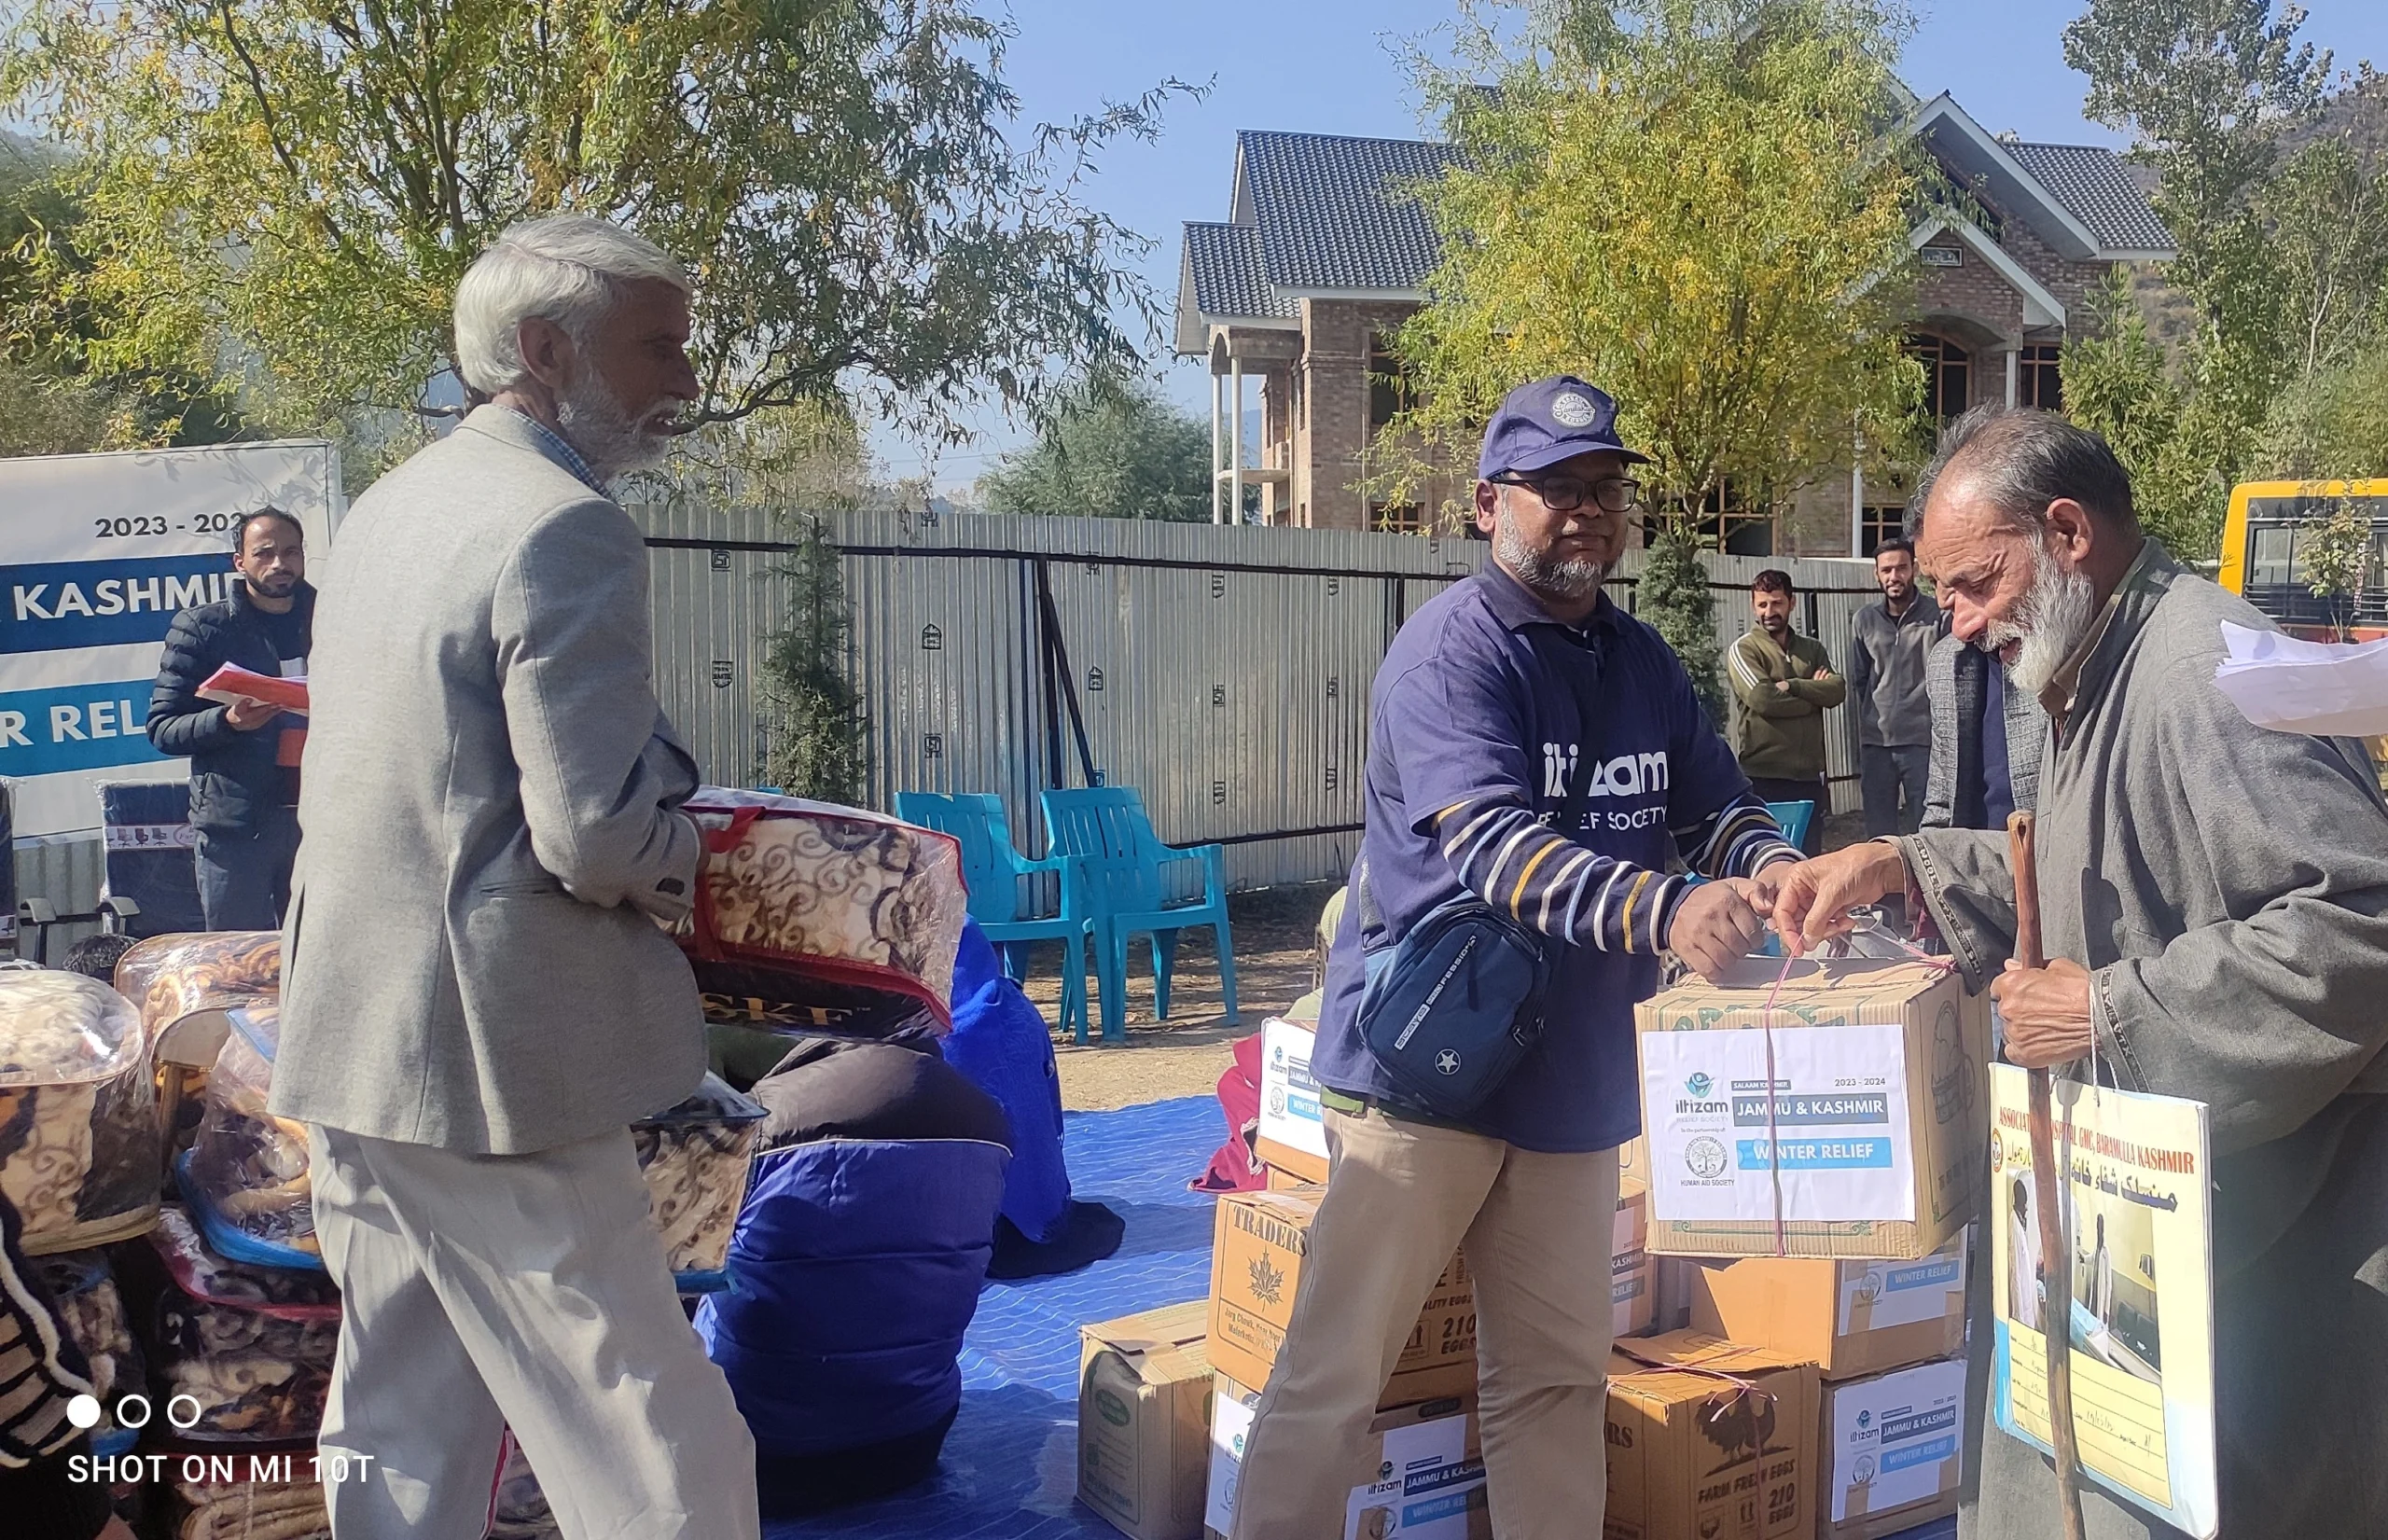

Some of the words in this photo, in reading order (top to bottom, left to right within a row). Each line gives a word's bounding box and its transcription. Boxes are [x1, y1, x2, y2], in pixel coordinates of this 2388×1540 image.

[95, 516, 168, 537] 2023
[193, 512, 245, 534] 202
[49, 698, 153, 743] REL
[1835, 1078, 1856, 1087] 2023
[1864, 1077, 1886, 1086] 2024
[1675, 1099, 1729, 1114] iltizam
[1737, 1102, 1792, 1117] JAMMU
[1796, 1102, 1809, 1116] &
[1812, 1099, 1884, 1115] KASHMIR
[1756, 1144, 1817, 1160] WNTER
[1821, 1143, 1874, 1159] RELIEF
[2095, 1131, 2137, 1166] BARAMULLA
[2137, 1144, 2195, 1174] KASHMIR
[1712, 1178, 1735, 1186] SOCIETY
[1233, 1203, 1308, 1257] TRADERS
[1895, 1271, 1925, 1284] WINTER
[1927, 1265, 1951, 1278] RELIEF
[1422, 1297, 1449, 1311] ALITY
[1442, 1313, 1477, 1339] 210
[1882, 1421, 1911, 1436] JAMMU
[1912, 1420, 1920, 1429] &
[1921, 1409, 1954, 1427] KASHMIR
[1888, 1447, 1922, 1464] WINTER
[1406, 1471, 1440, 1490] JAMMU
[1441, 1469, 1450, 1480] &
[1698, 1482, 1732, 1505] FARM
[1770, 1459, 1796, 1480] EGGS
